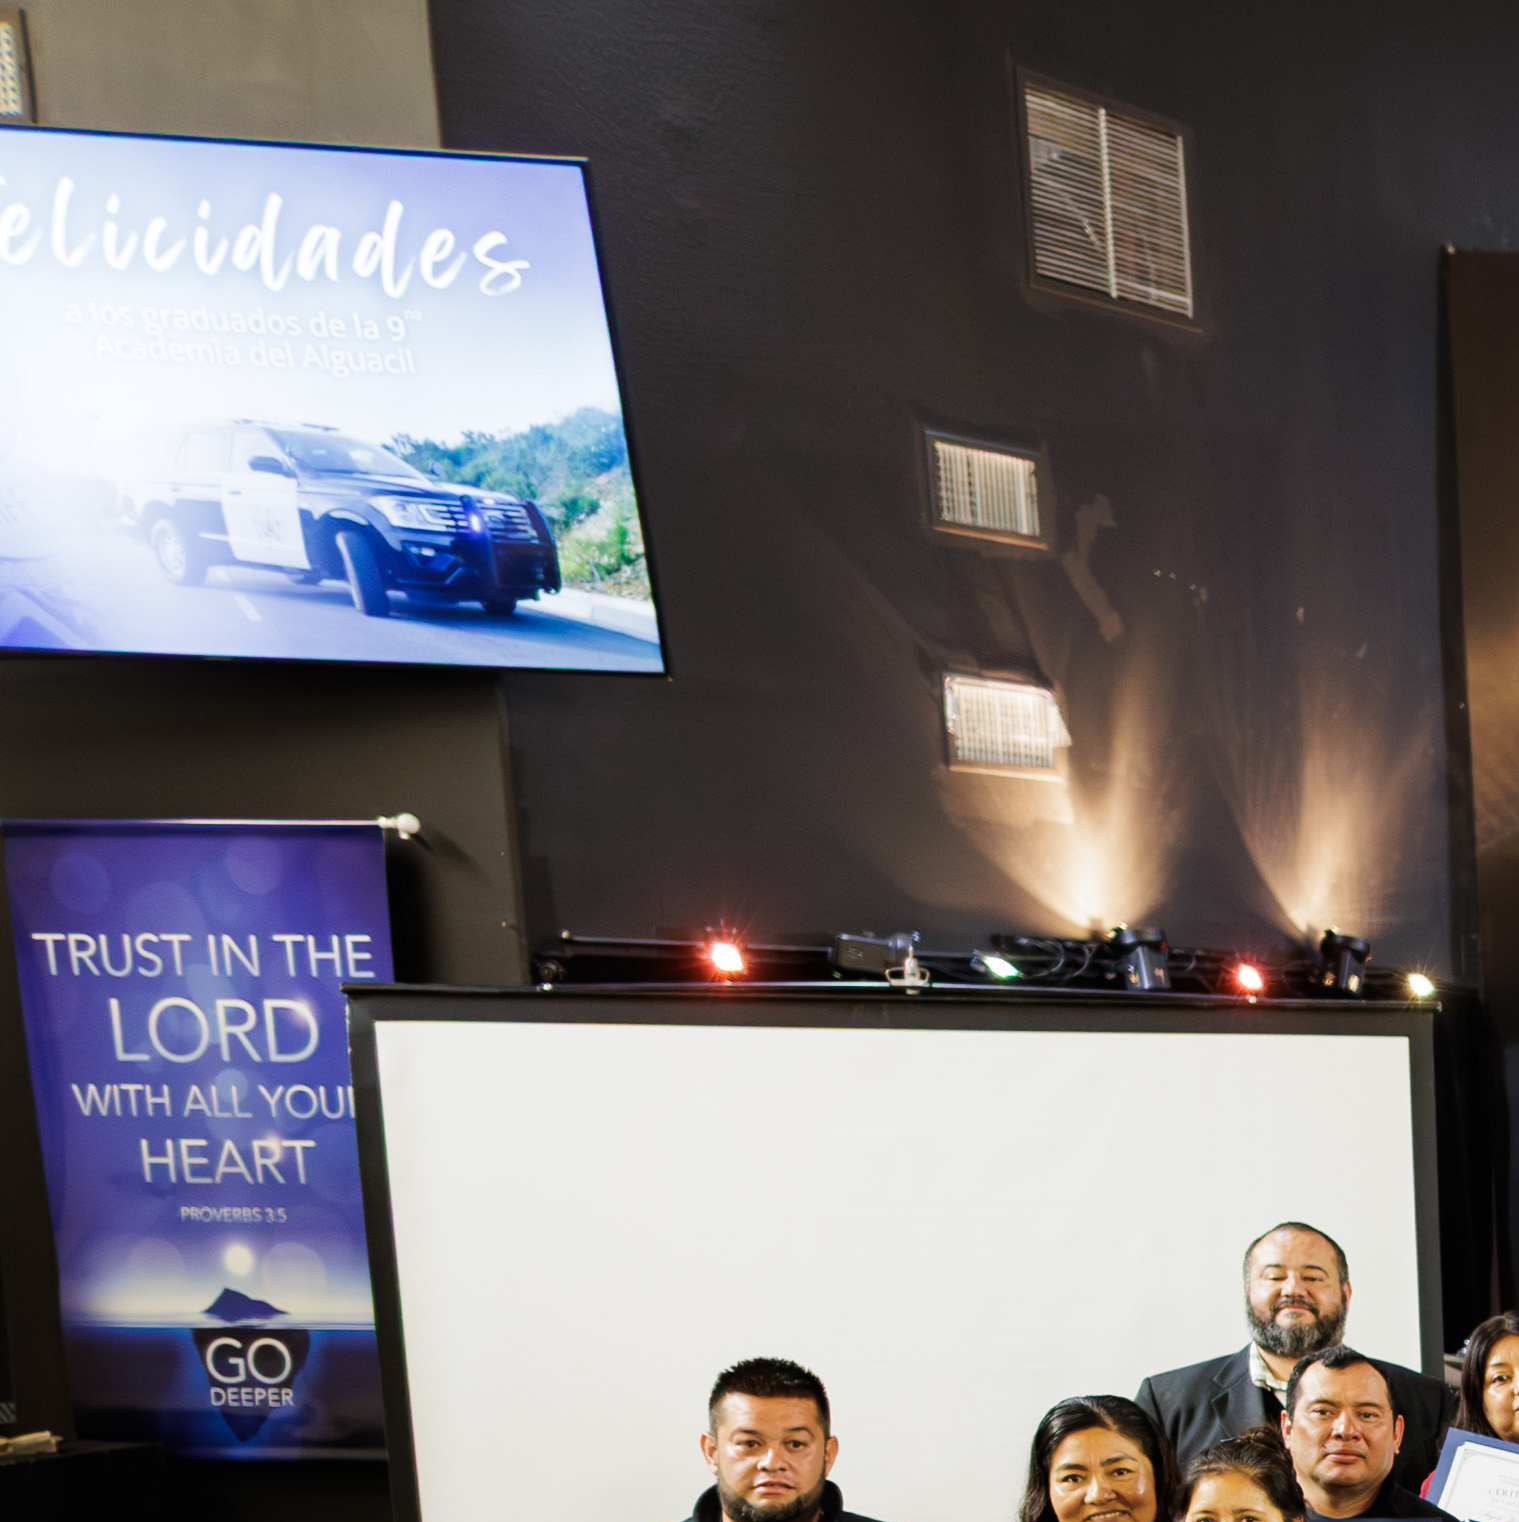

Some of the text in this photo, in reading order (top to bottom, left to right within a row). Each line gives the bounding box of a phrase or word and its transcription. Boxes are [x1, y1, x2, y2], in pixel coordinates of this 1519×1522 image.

[0, 177, 530, 298] elicidades
[90, 300, 133, 327] los
[142, 304, 301, 334] graduados
[310, 312, 346, 338] de
[353, 313, 380, 340] la
[96, 334, 415, 376] Academia del Alguacil
[31, 933, 376, 978] TRUST IN THE
[109, 997, 319, 1062] LORD
[71, 1084, 171, 1117] WITH
[184, 1085, 253, 1118] ALL
[140, 1139, 316, 1184] HEART
[181, 1206, 287, 1224] PROVERBS 3:5
[206, 1337, 292, 1384] GO
[210, 1387, 295, 1408] DEEPER
